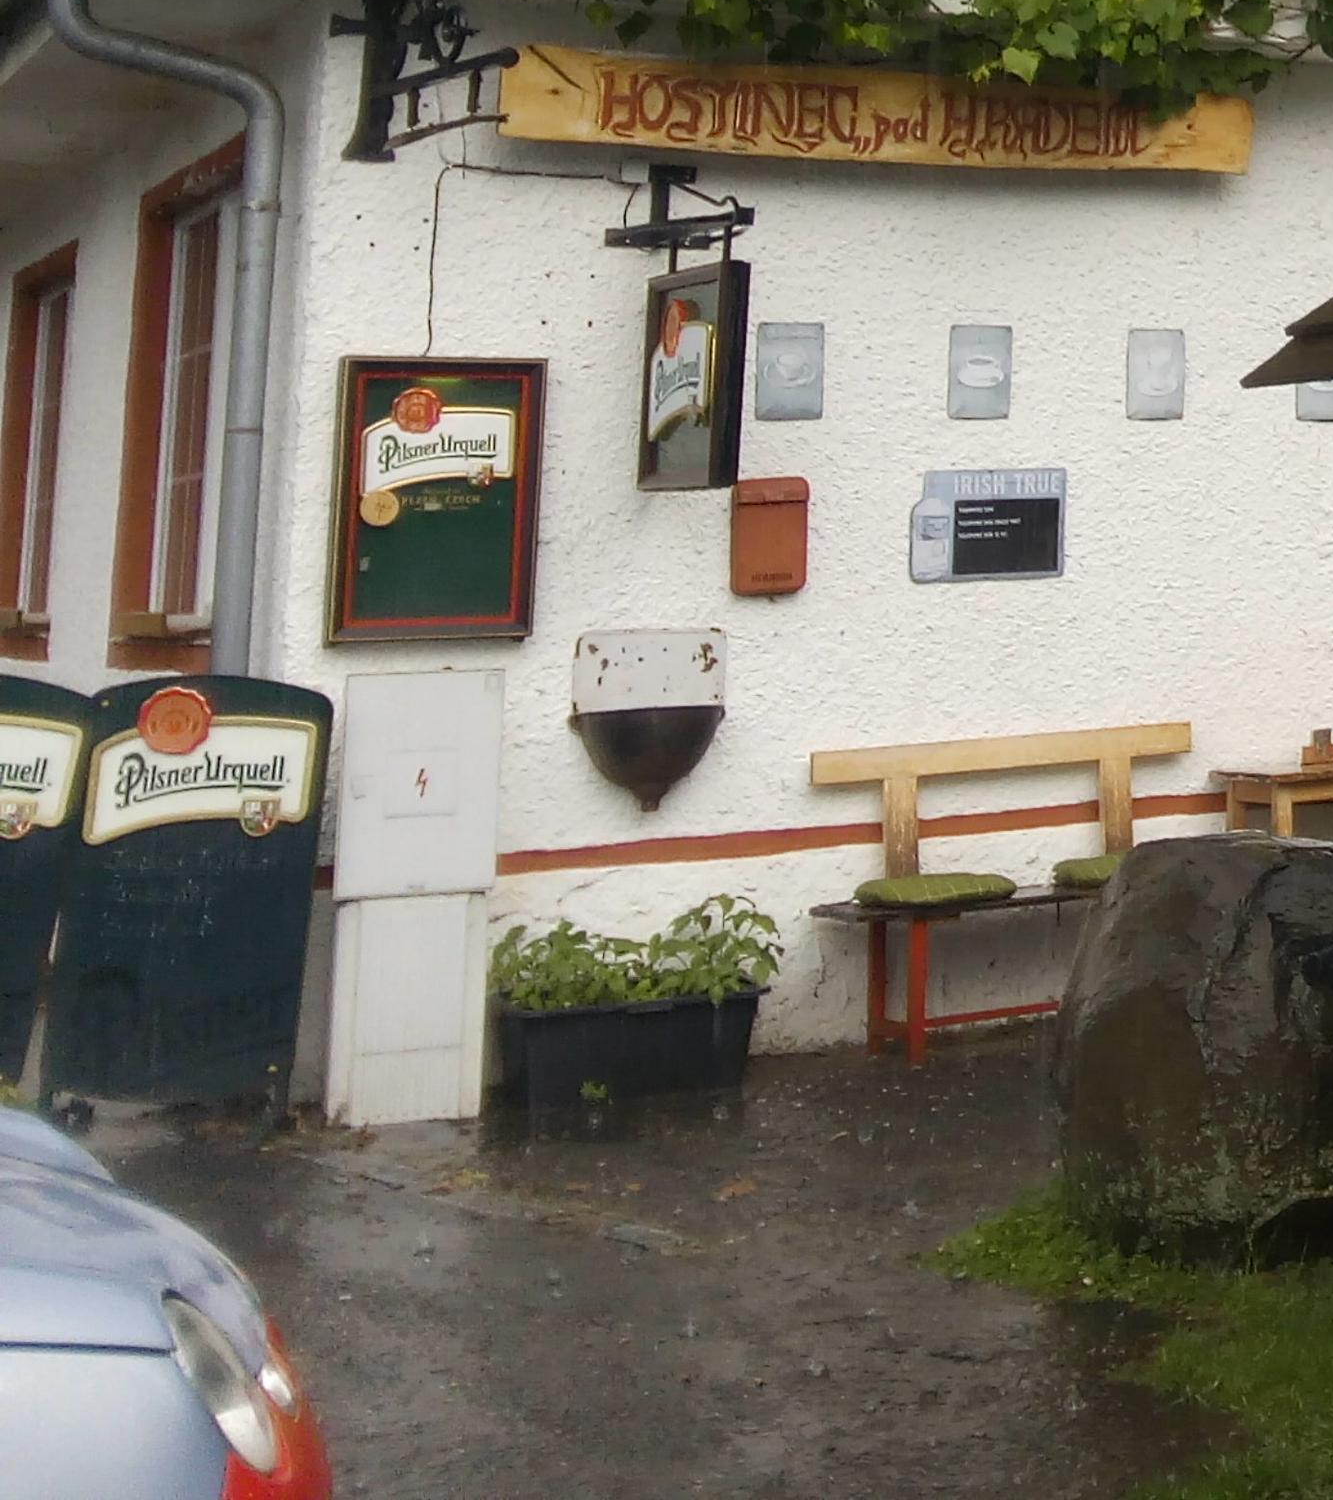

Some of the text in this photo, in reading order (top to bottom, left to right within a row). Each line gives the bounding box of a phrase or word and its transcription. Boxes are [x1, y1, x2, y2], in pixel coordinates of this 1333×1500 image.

[598, 70, 860, 154] HOSTINEC
[378, 432, 497, 474] Pilsner Urquell
[953, 472, 1061, 495] IRISH TRUE
[114, 751, 286, 809] Pilsner Urquell
